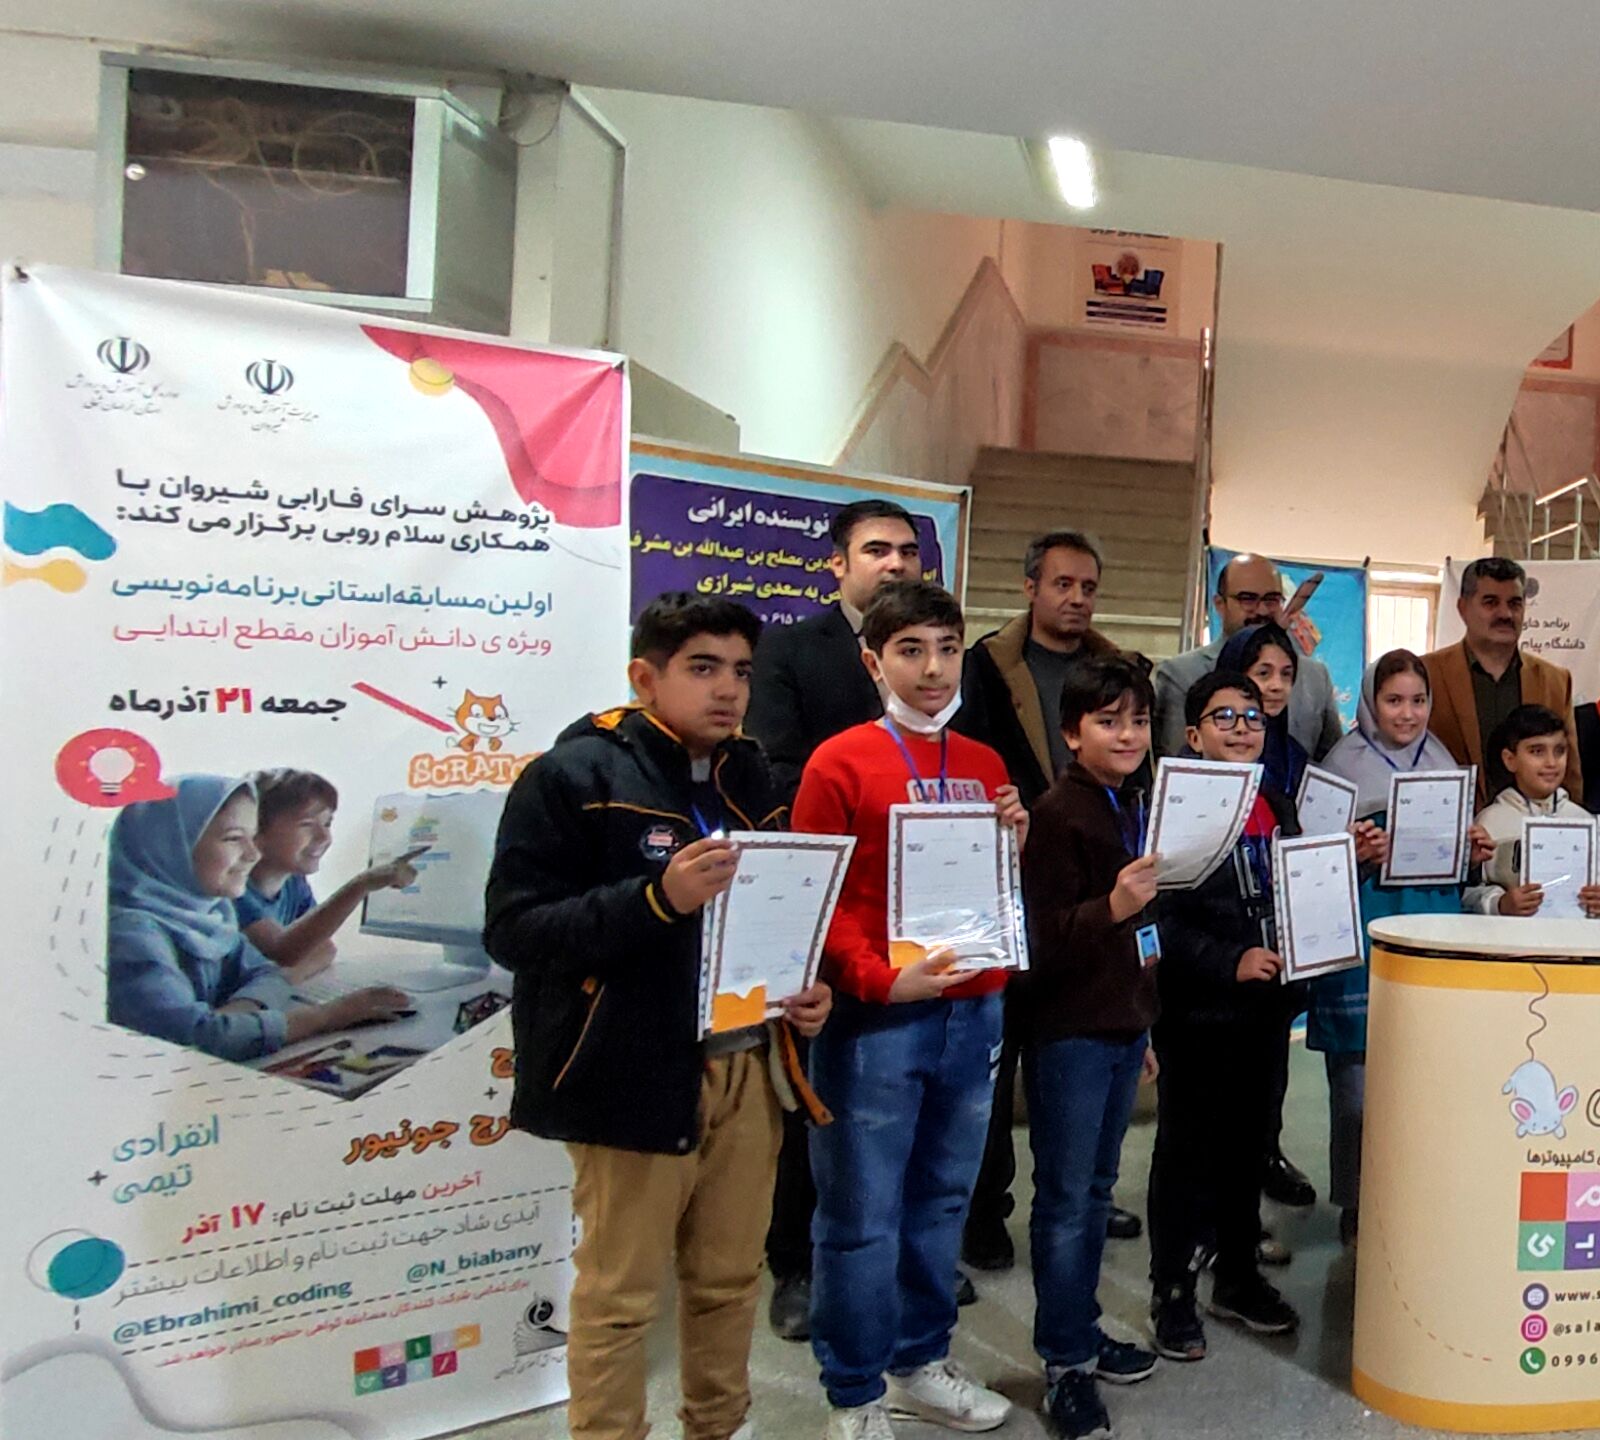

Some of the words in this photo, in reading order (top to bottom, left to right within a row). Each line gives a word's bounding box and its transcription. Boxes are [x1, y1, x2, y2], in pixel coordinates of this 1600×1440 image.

[116, 468, 151, 496] با
[159, 476, 269, 504] شیروان
[277, 486, 364, 512] فارابی
[371, 495, 446, 518] سرای
[687, 496, 752, 528] ایرانی
[187, 516, 231, 533] می
[233, 512, 316, 540] برگزار
[453, 500, 550, 533] پژوهش
[754, 510, 830, 539] نویسنده
[322, 526, 380, 545] روبی
[385, 525, 445, 547] سلام
[450, 531, 550, 553] همکاری
[673, 540, 693, 558] بن
[695, 537, 744, 563] عبدالله
[746, 550, 765, 566] بن
[766, 548, 803, 568] مصلح
[301, 580, 391, 606] استانی
[696, 572, 755, 596] شیرازی
[756, 580, 803, 599] سعدی
[804, 586, 819, 600] به
[393, 585, 487, 612] مسابقه
[487, 591, 553, 617] اولین
[113, 613, 228, 643] ابتدایی
[233, 618, 314, 649] مقطع
[319, 622, 396, 650] آموزان
[1543, 617, 1570, 632] برنامه
[399, 627, 476, 651] دانش
[481, 635, 502, 653] ی
[507, 630, 552, 656] ویژه
[1520, 637, 1543, 653] پیام
[1544, 637, 1586, 650] دانشگاه
[216, 688, 253, 713] ۲۱
[260, 697, 347, 722] جمعه
[112, 1114, 219, 1162] انفرادی
[342, 1118, 460, 1165] جونیور
[1526, 1148, 1595, 1168] کامپیوترها
[113, 1163, 193, 1204] تیمی
[361, 1186, 417, 1206] مهلت
[422, 1170, 483, 1200] آخرین
[231, 1201, 265, 1229] ۱۷
[314, 1192, 355, 1214] ثبت
[181, 1213, 221, 1244] آذر
[453, 1212, 489, 1236] شاد
[493, 1201, 540, 1233] آیدی
[342, 1231, 387, 1256] ثبت
[392, 1226, 448, 1246] جهت
[193, 1248, 288, 1285] اطلاعات
[292, 1253, 304, 1272] و
[308, 1238, 337, 1269] نام
[406, 1241, 543, 1284] @N_biabany
[111, 1275, 188, 1308] بیشتر
[113, 1280, 353, 1345] @Ebrahimi_coding
